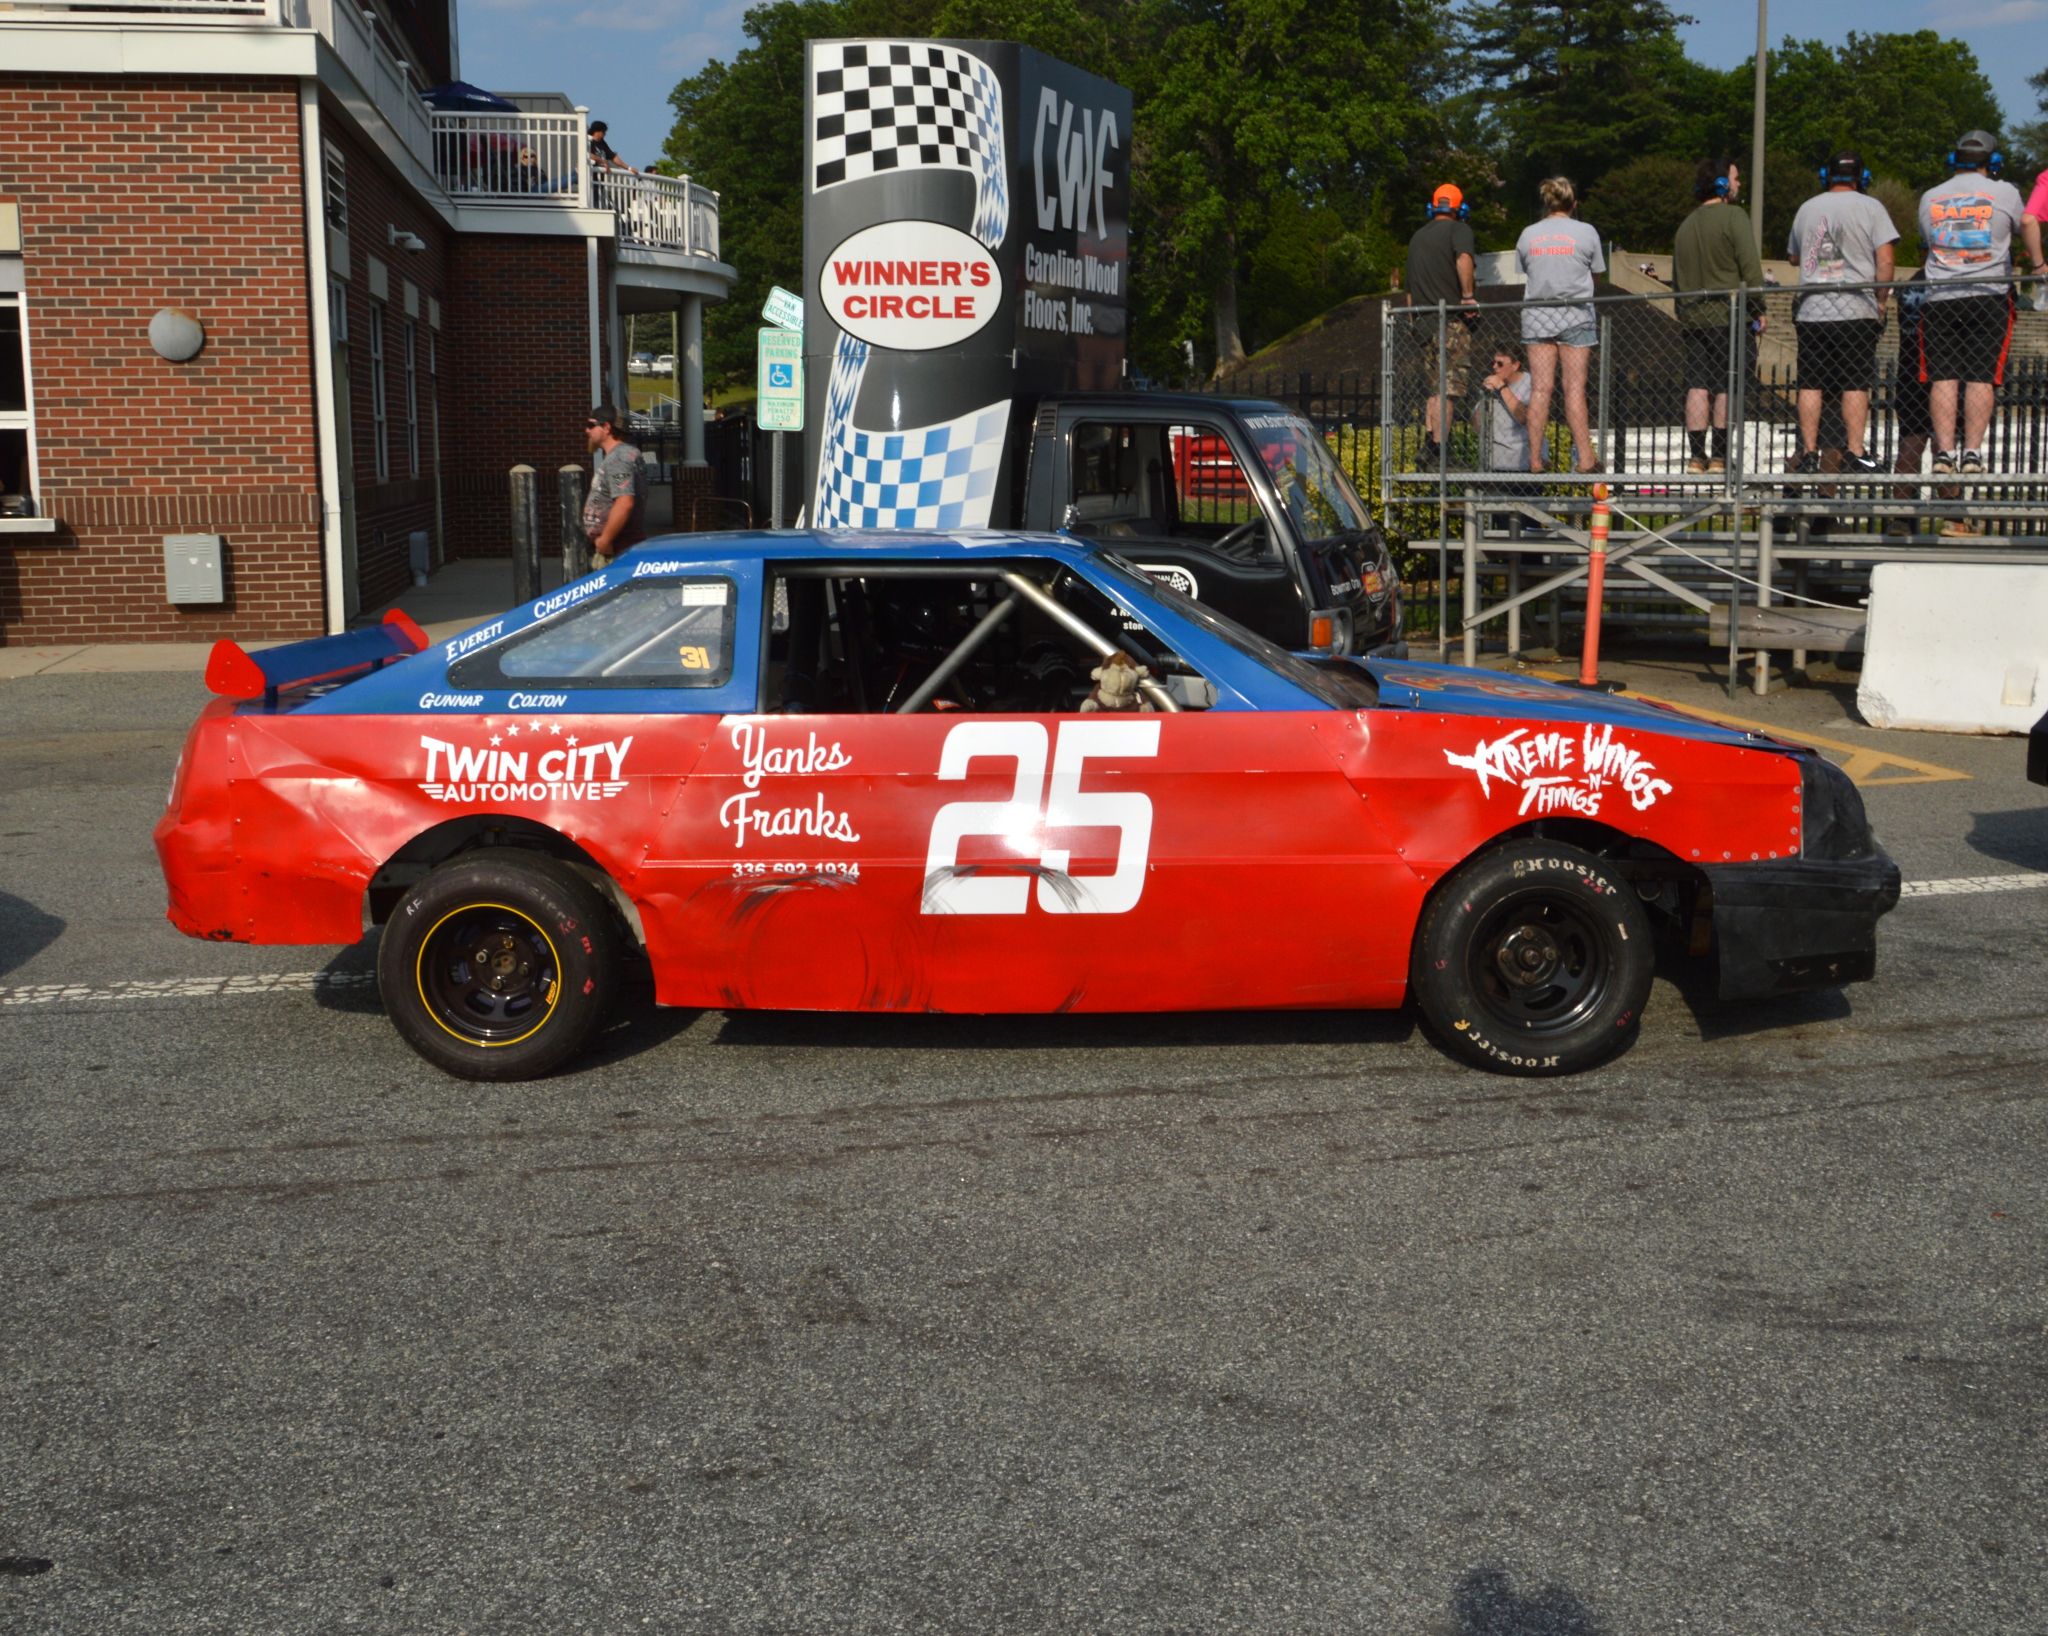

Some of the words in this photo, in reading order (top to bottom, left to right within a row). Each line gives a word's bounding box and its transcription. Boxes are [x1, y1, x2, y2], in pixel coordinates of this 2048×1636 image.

[833, 261, 991, 287] WINNER'S
[1025, 242, 1081, 289] Carolina
[1085, 254, 1119, 296] Wood
[783, 299, 796, 312] VAN
[843, 295, 976, 319] CIRCLE
[1024, 290, 1068, 335] Floors,
[1071, 297, 1094, 335] Inc.
[762, 336, 801, 347] RESERVED
[765, 346, 798, 359] PARKING
[632, 561, 679, 577] LOGAN
[534, 574, 608, 619] CHEYENNE
[446, 620, 504, 662] EVERETT
[680, 645, 711, 669] 31
[419, 692, 484, 709] GUNNAR
[508, 692, 567, 709] COLTON
[420, 735, 528, 782] TWIN
[537, 735, 634, 782] CITY
[731, 723, 853, 788] Yanks
[1444, 727, 1576, 800] XTREME
[1582, 722, 1673, 811] WINGS
[442, 781, 601, 802] AUTOMOTIVE
[1517, 775, 1603, 816] THINGS
[719, 790, 861, 848] Franks
[920, 720, 1161, 915] 25
[732, 862, 766, 878] 336
[406, 899, 423, 916] RF
